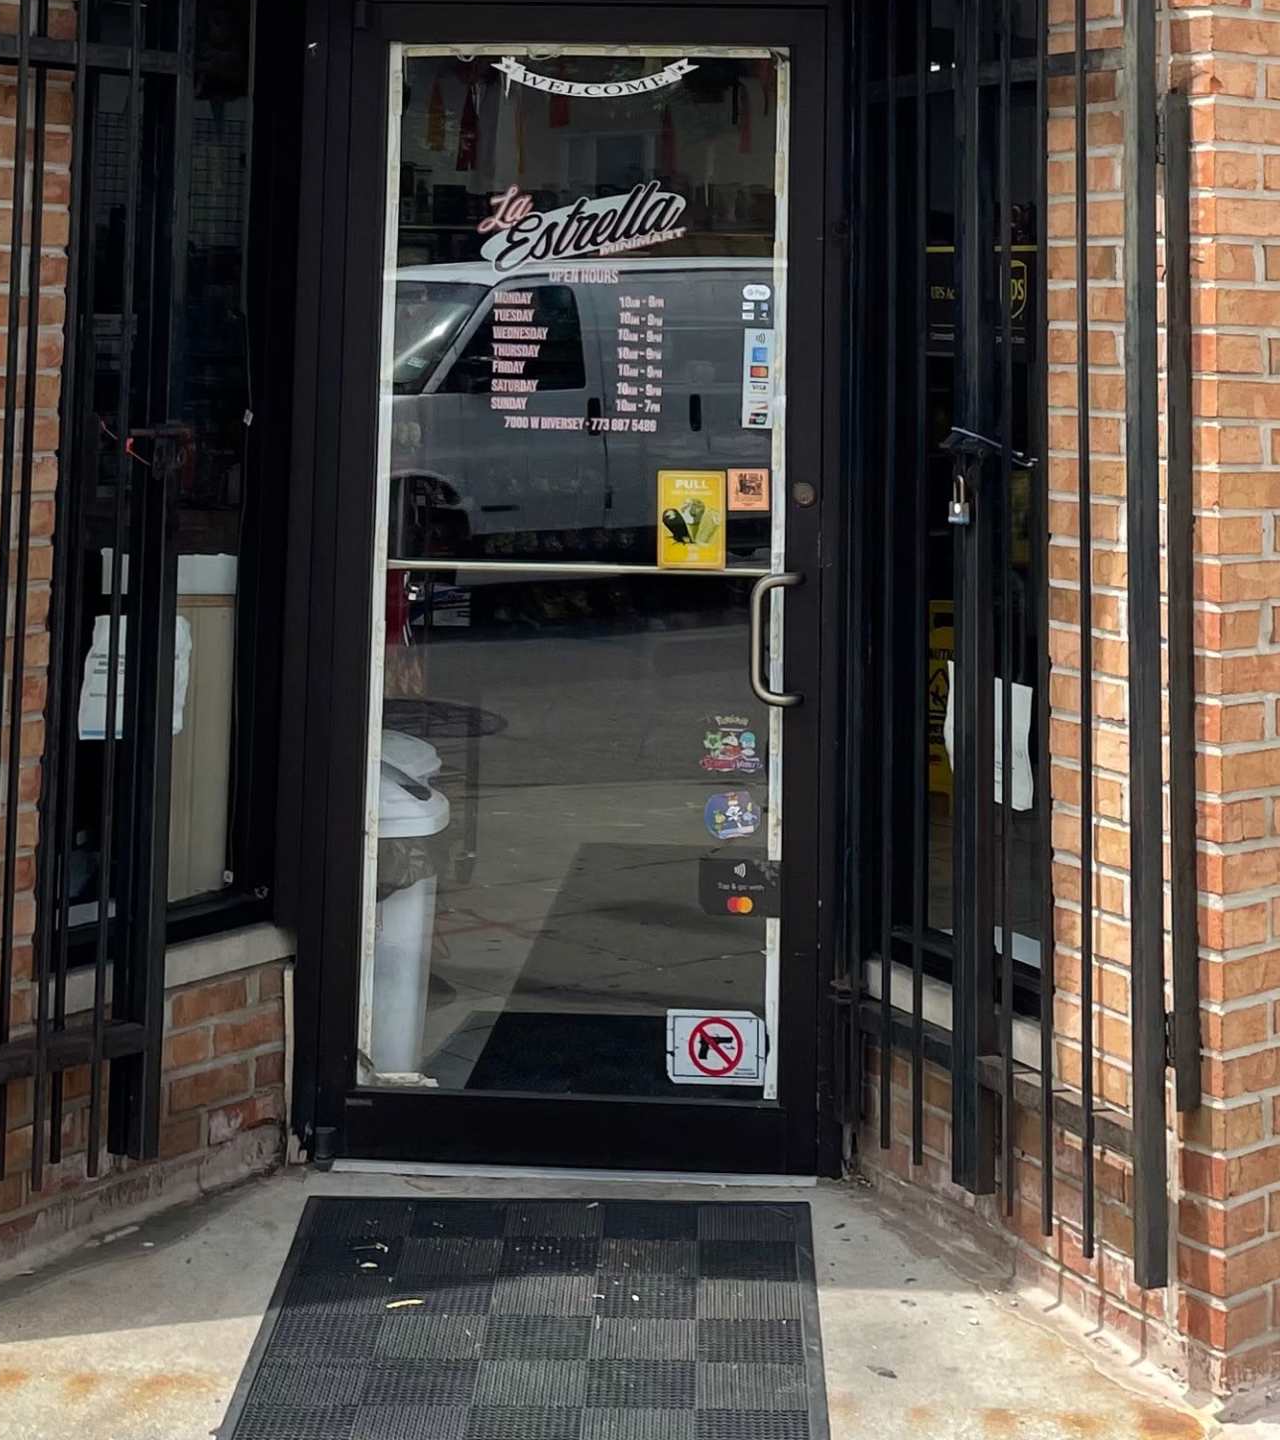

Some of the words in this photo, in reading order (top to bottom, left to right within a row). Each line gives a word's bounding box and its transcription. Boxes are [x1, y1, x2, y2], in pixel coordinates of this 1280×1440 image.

[522, 71, 665, 95] WELCOME
[477, 184, 533, 233] La
[495, 181, 681, 271] Estrella
[549, 269, 579, 282] OPEN
[581, 270, 619, 283] HOURS
[494, 291, 533, 304] MONDAY
[493, 309, 535, 321] TUESDAY
[493, 326, 549, 339] WEDNESDAY
[492, 344, 540, 357] THURSDAY
[492, 361, 525, 373] FRIDAY
[491, 379, 539, 392] SATURDAY
[491, 397, 528, 409] SUNDAY
[531, 417, 539, 428] W
[541, 417, 584, 430] DIVERSEY
[591, 418, 609, 431] 773
[675, 479, 709, 489] PULL
